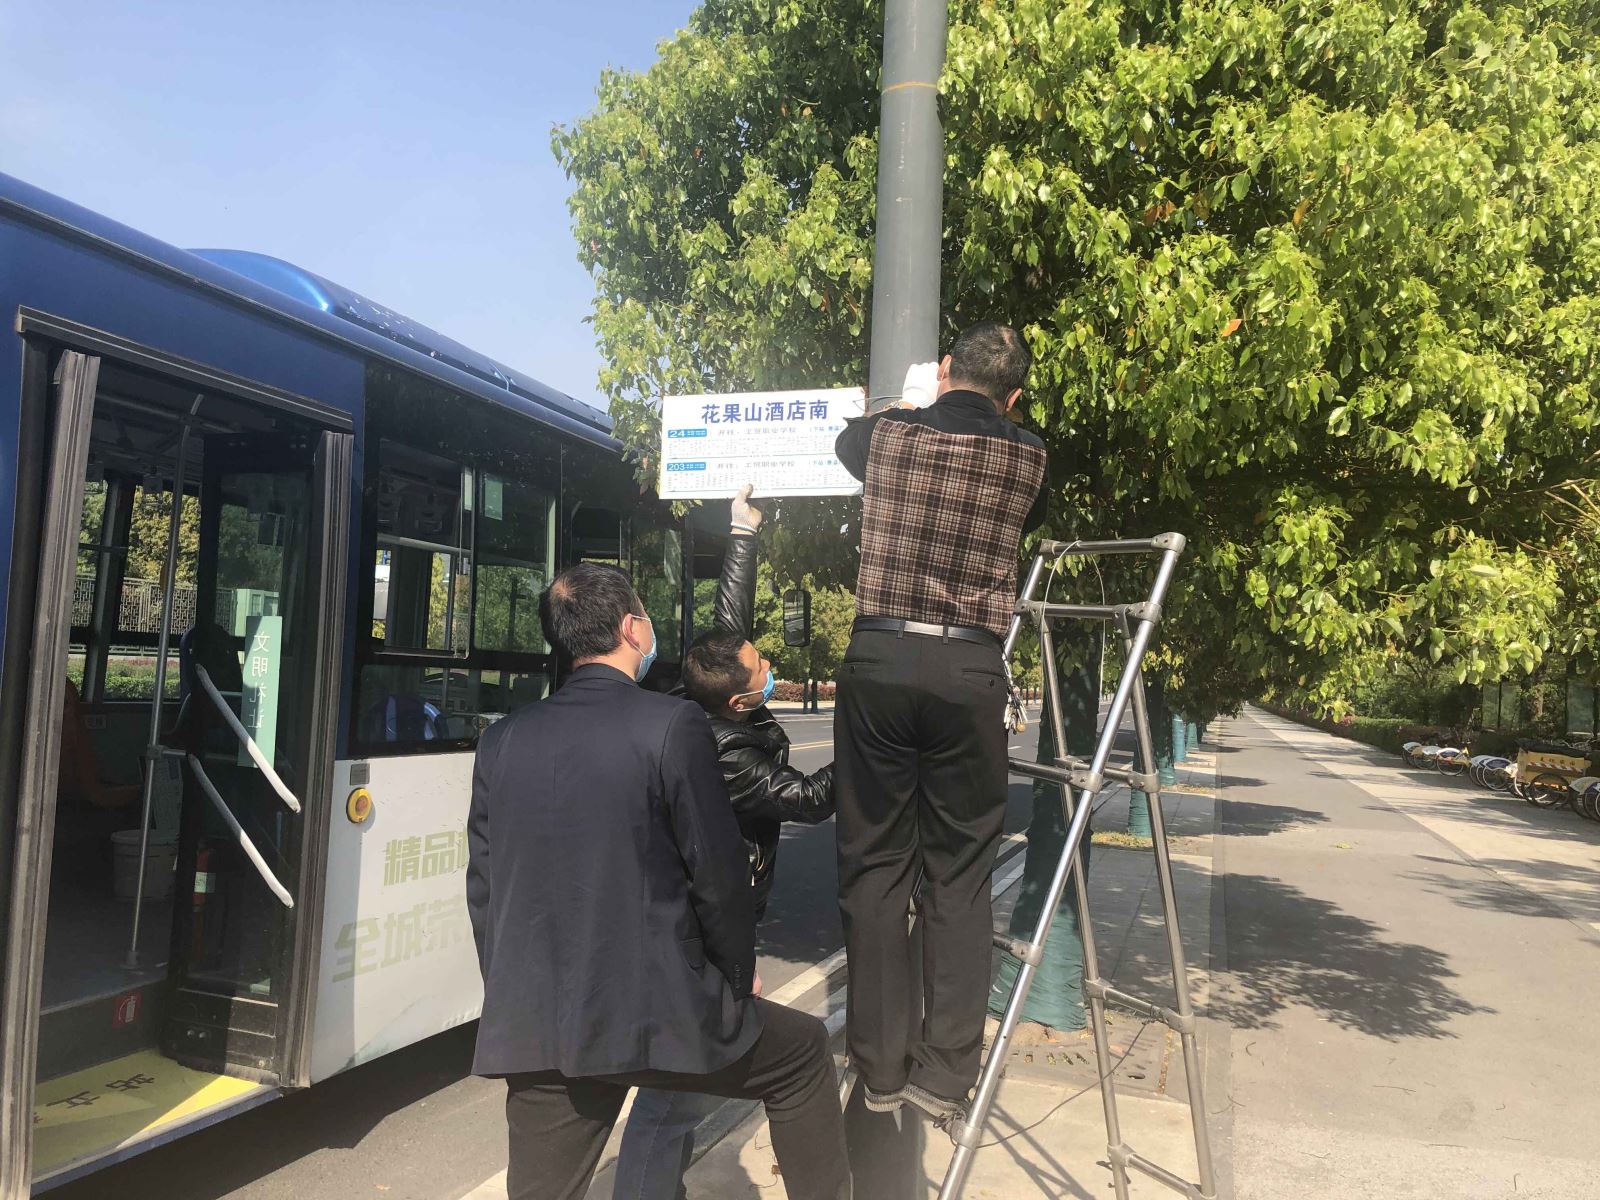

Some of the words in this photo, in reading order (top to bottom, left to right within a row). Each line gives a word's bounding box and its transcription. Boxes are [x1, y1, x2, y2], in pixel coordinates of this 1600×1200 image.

[701, 400, 830, 424] 花果山酒店南
[669, 429, 685, 438] 24
[668, 463, 685, 471] 203
